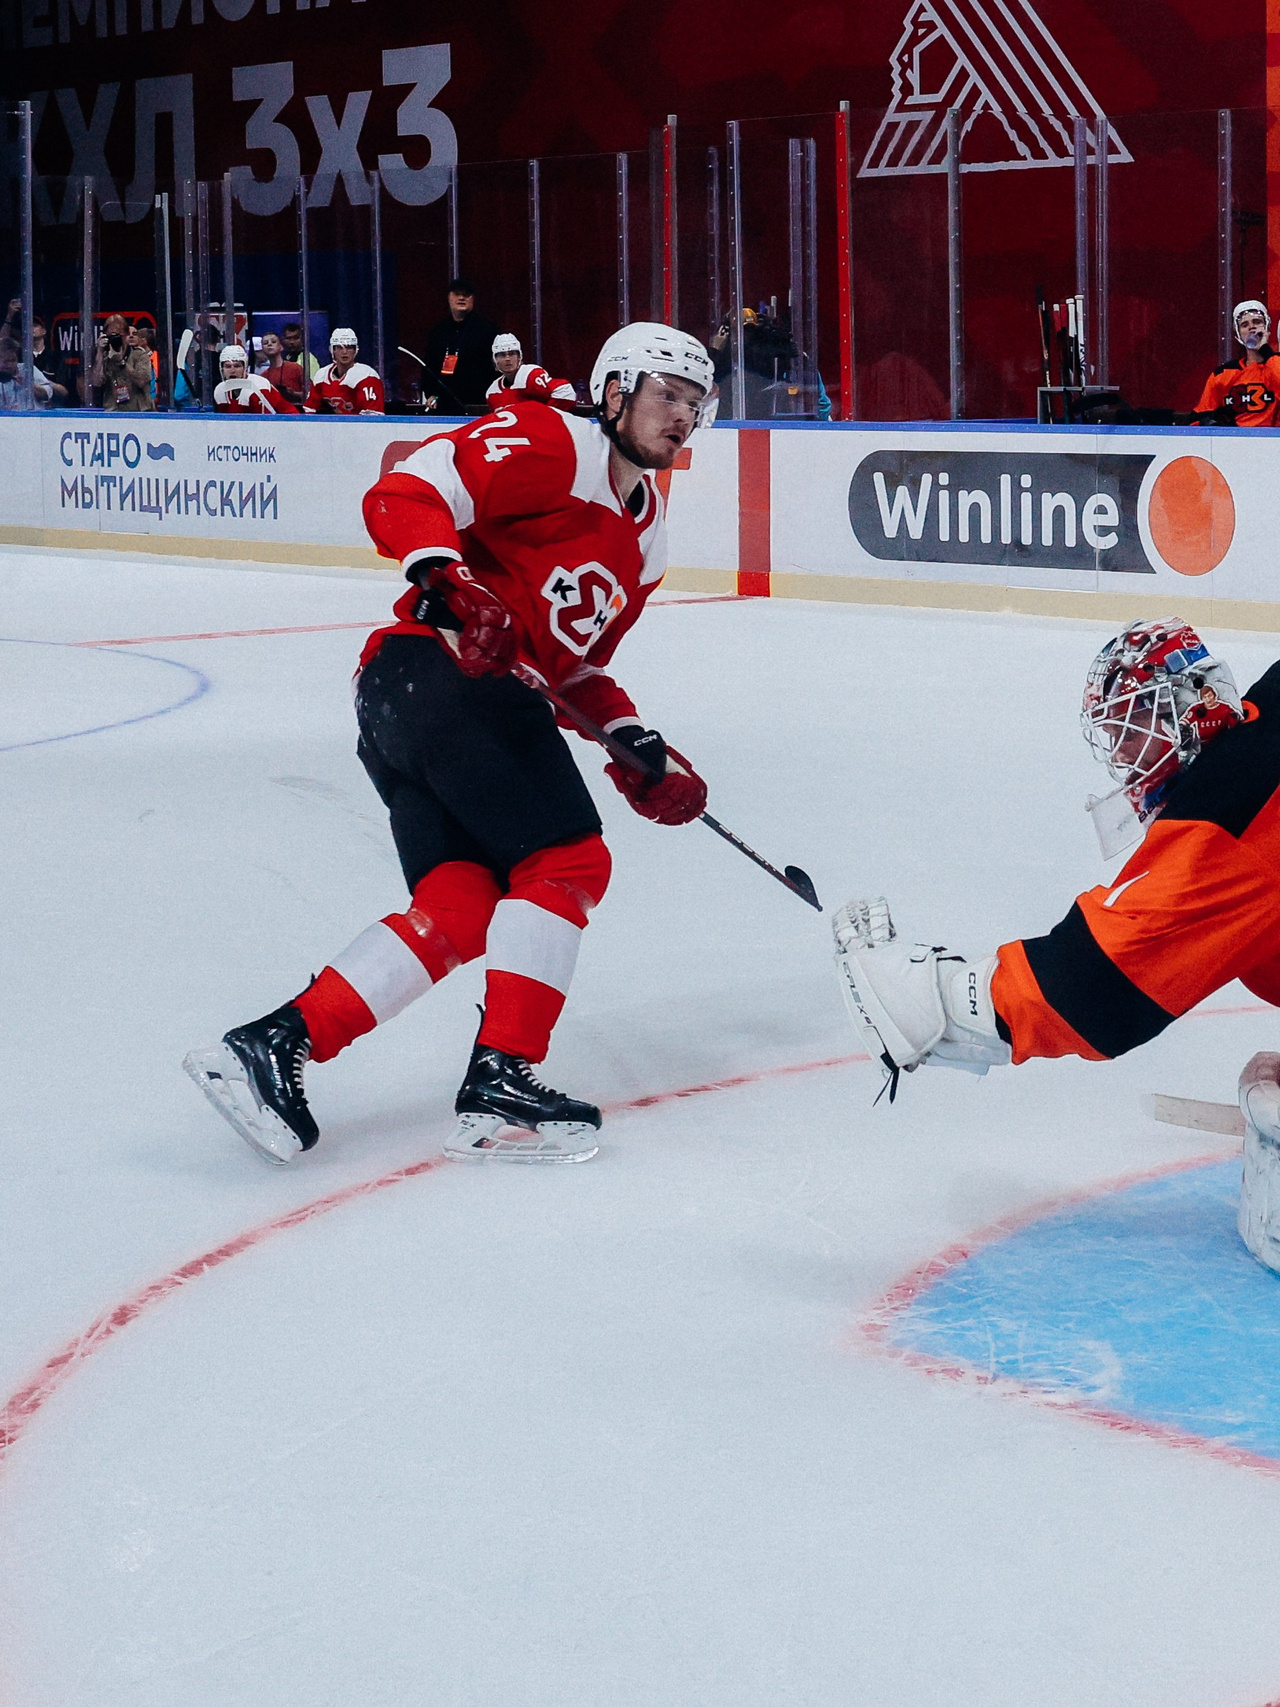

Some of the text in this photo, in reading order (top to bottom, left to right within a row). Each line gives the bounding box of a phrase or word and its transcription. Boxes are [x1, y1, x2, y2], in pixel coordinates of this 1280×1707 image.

[684, 351, 709, 366] CCM
[534, 370, 552, 388] 92
[362, 386, 376, 401] 14
[60, 431, 141, 469] СТАРО
[467, 410, 531, 463] 24
[207, 445, 277, 463] ИСТОЧНИК
[60, 474, 278, 521] МЫТИЩИНСКИЙ
[873, 471, 1120, 548] Winline
[633, 733, 658, 746] CCM
[968, 972, 978, 1016] CCM
